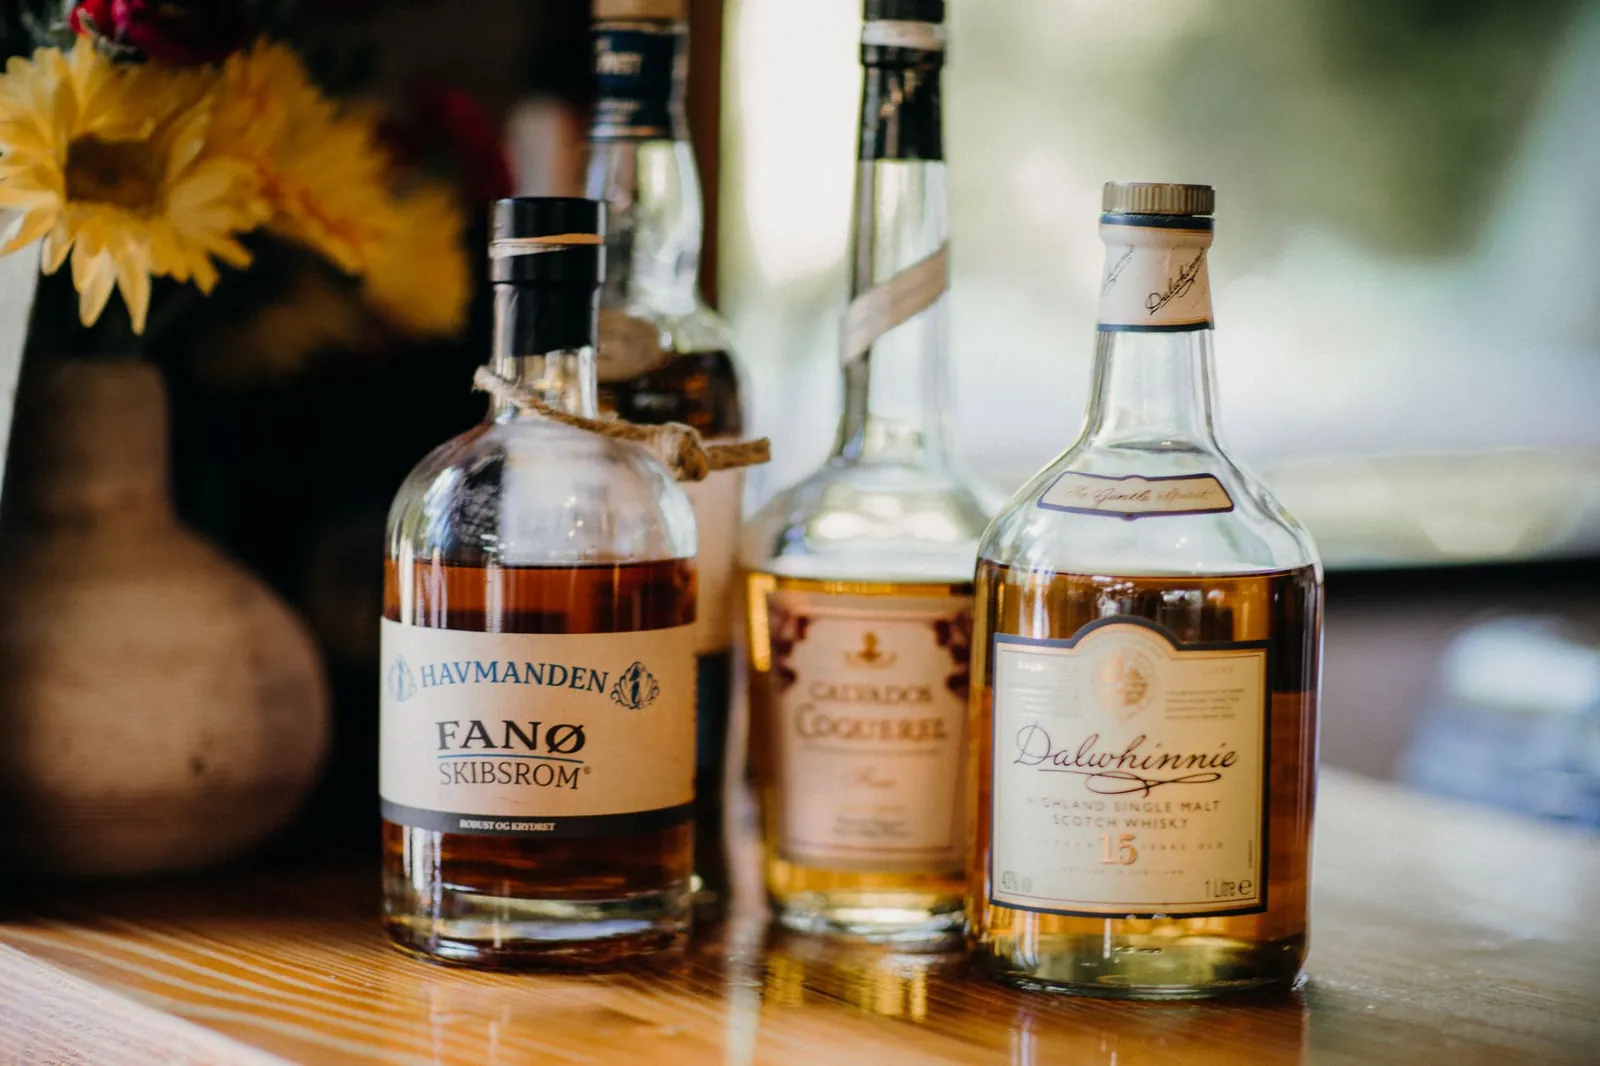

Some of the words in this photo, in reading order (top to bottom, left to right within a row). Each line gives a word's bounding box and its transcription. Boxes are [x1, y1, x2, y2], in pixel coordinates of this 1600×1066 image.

[420, 660, 609, 693] HAVMANDEN
[435, 720, 586, 754] FANØ
[1013, 721, 1237, 771] Dalwhinnie
[1053, 814, 1117, 828] SCOTCH
[1124, 818, 1189, 829] WHISKY
[1114, 801, 1171, 813] SINGLE
[1180, 800, 1220, 813] MALT
[459, 818, 495, 830] ROBUST
[495, 821, 510, 831] OG
[1098, 833, 1138, 865] 15
